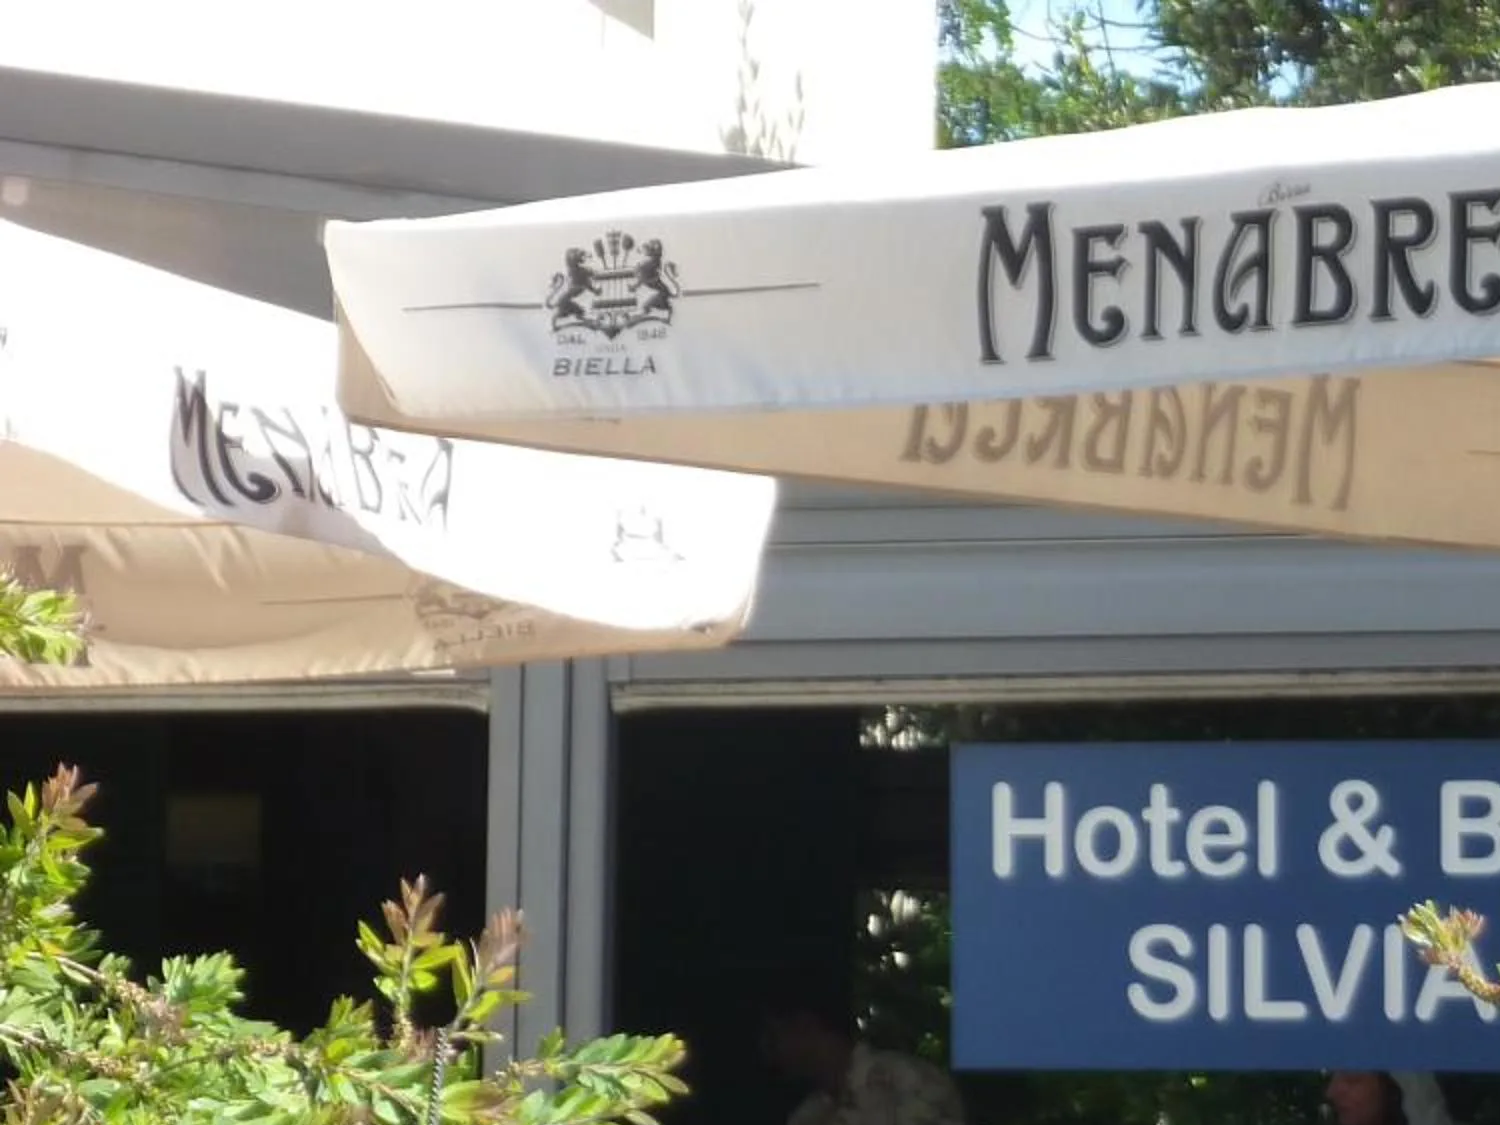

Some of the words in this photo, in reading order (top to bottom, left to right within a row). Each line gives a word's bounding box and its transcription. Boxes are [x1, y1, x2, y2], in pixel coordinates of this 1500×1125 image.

[553, 355, 656, 376] BIELLA
[992, 780, 1278, 878] Hotel
[1318, 778, 1402, 878] &
[1127, 922, 1498, 1023] SILVIA
